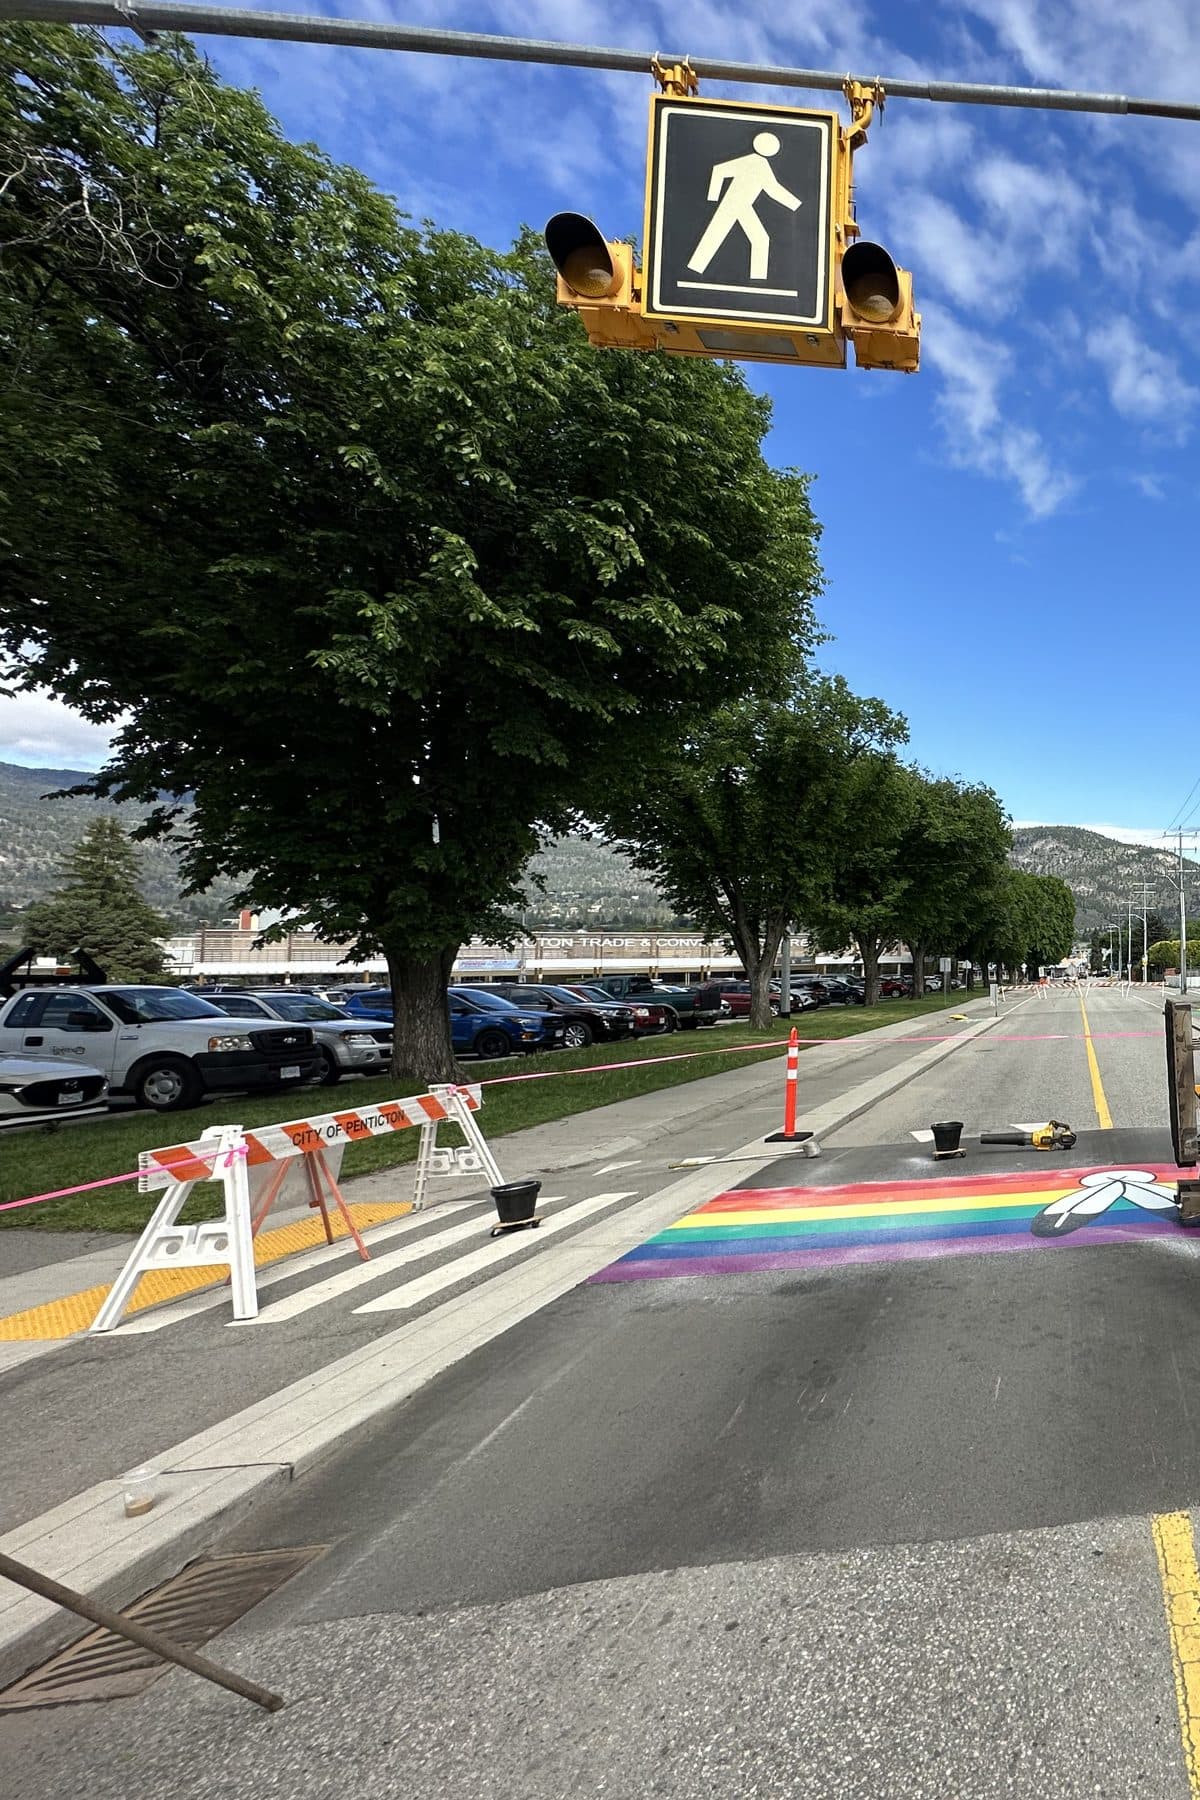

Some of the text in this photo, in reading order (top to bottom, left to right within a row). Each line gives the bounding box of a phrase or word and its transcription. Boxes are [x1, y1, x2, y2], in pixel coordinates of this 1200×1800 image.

[470, 937, 574, 947] PCTON
[579, 937, 635, 947] TRADE
[639, 938, 652, 947] &
[292, 1110, 406, 1146] CITY OF PENTICTON
